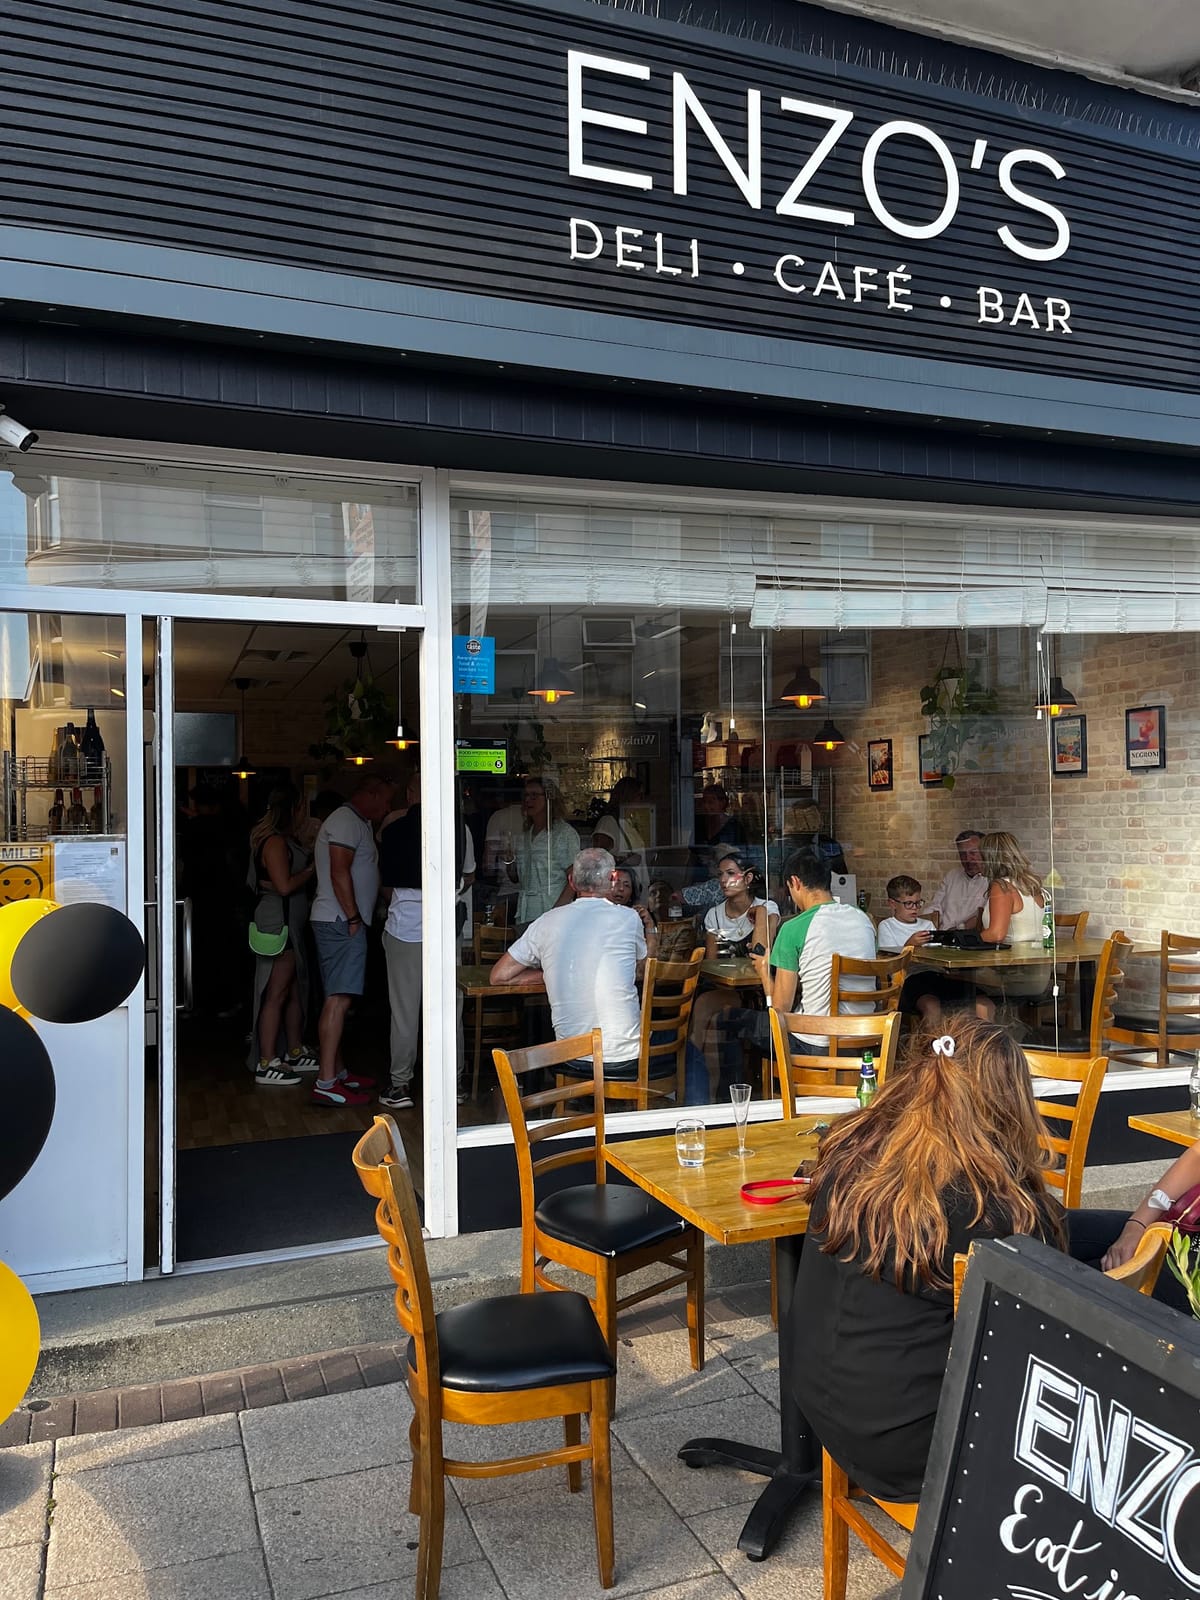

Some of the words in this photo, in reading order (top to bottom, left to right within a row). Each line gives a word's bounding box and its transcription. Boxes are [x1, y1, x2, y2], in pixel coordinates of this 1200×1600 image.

[566, 49, 1071, 262] ENZO'S
[569, 217, 700, 279] DELI
[773, 254, 914, 313] CAFÉ
[976, 286, 1074, 335] BAR
[0, 847, 43, 858] MILE!
[999, 1484, 1102, 1593] Eat
